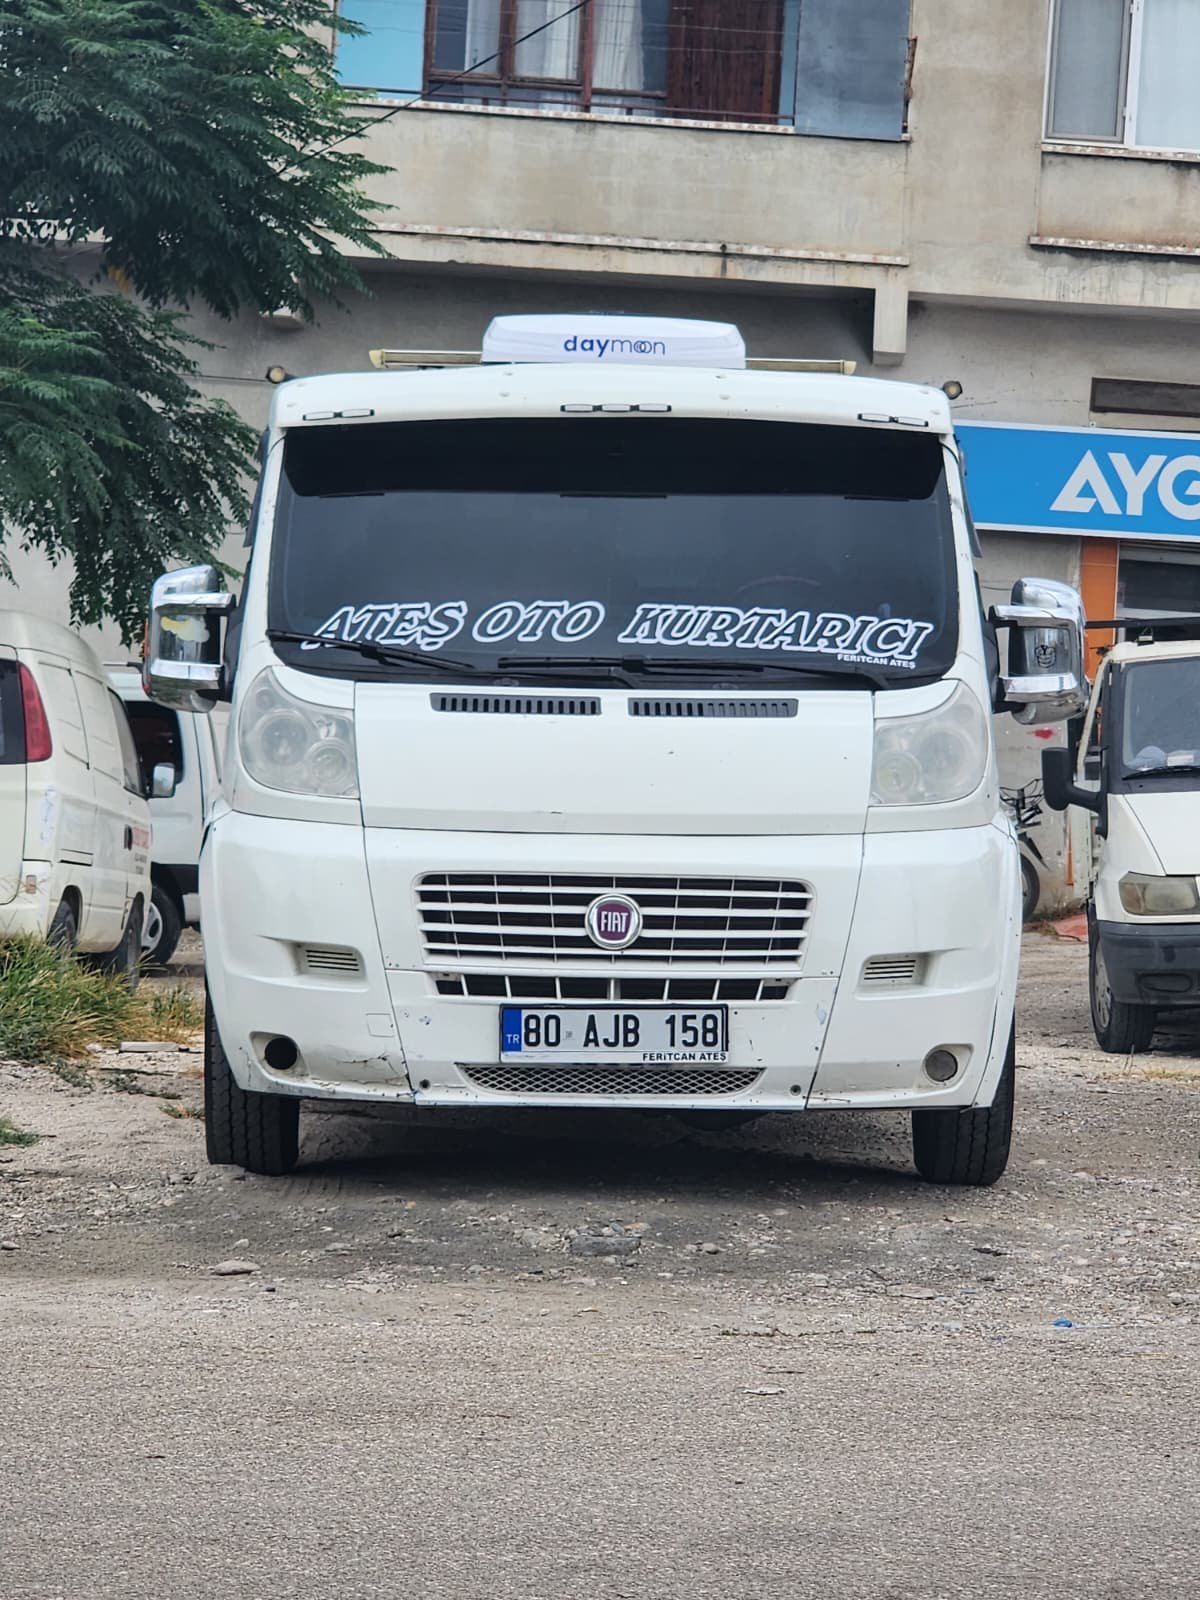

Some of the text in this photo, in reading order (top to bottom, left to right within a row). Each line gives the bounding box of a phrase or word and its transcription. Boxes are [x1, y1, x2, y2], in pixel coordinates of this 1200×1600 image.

[1049, 449, 1200, 521] AYG
[472, 600, 605, 642] OTO
[617, 604, 933, 660] KURTARICI
[600, 911, 629, 933] FIAT
[506, 1014, 719, 1048] TR 80 AJB 158
[699, 1052, 727, 1063] ATEŞ
